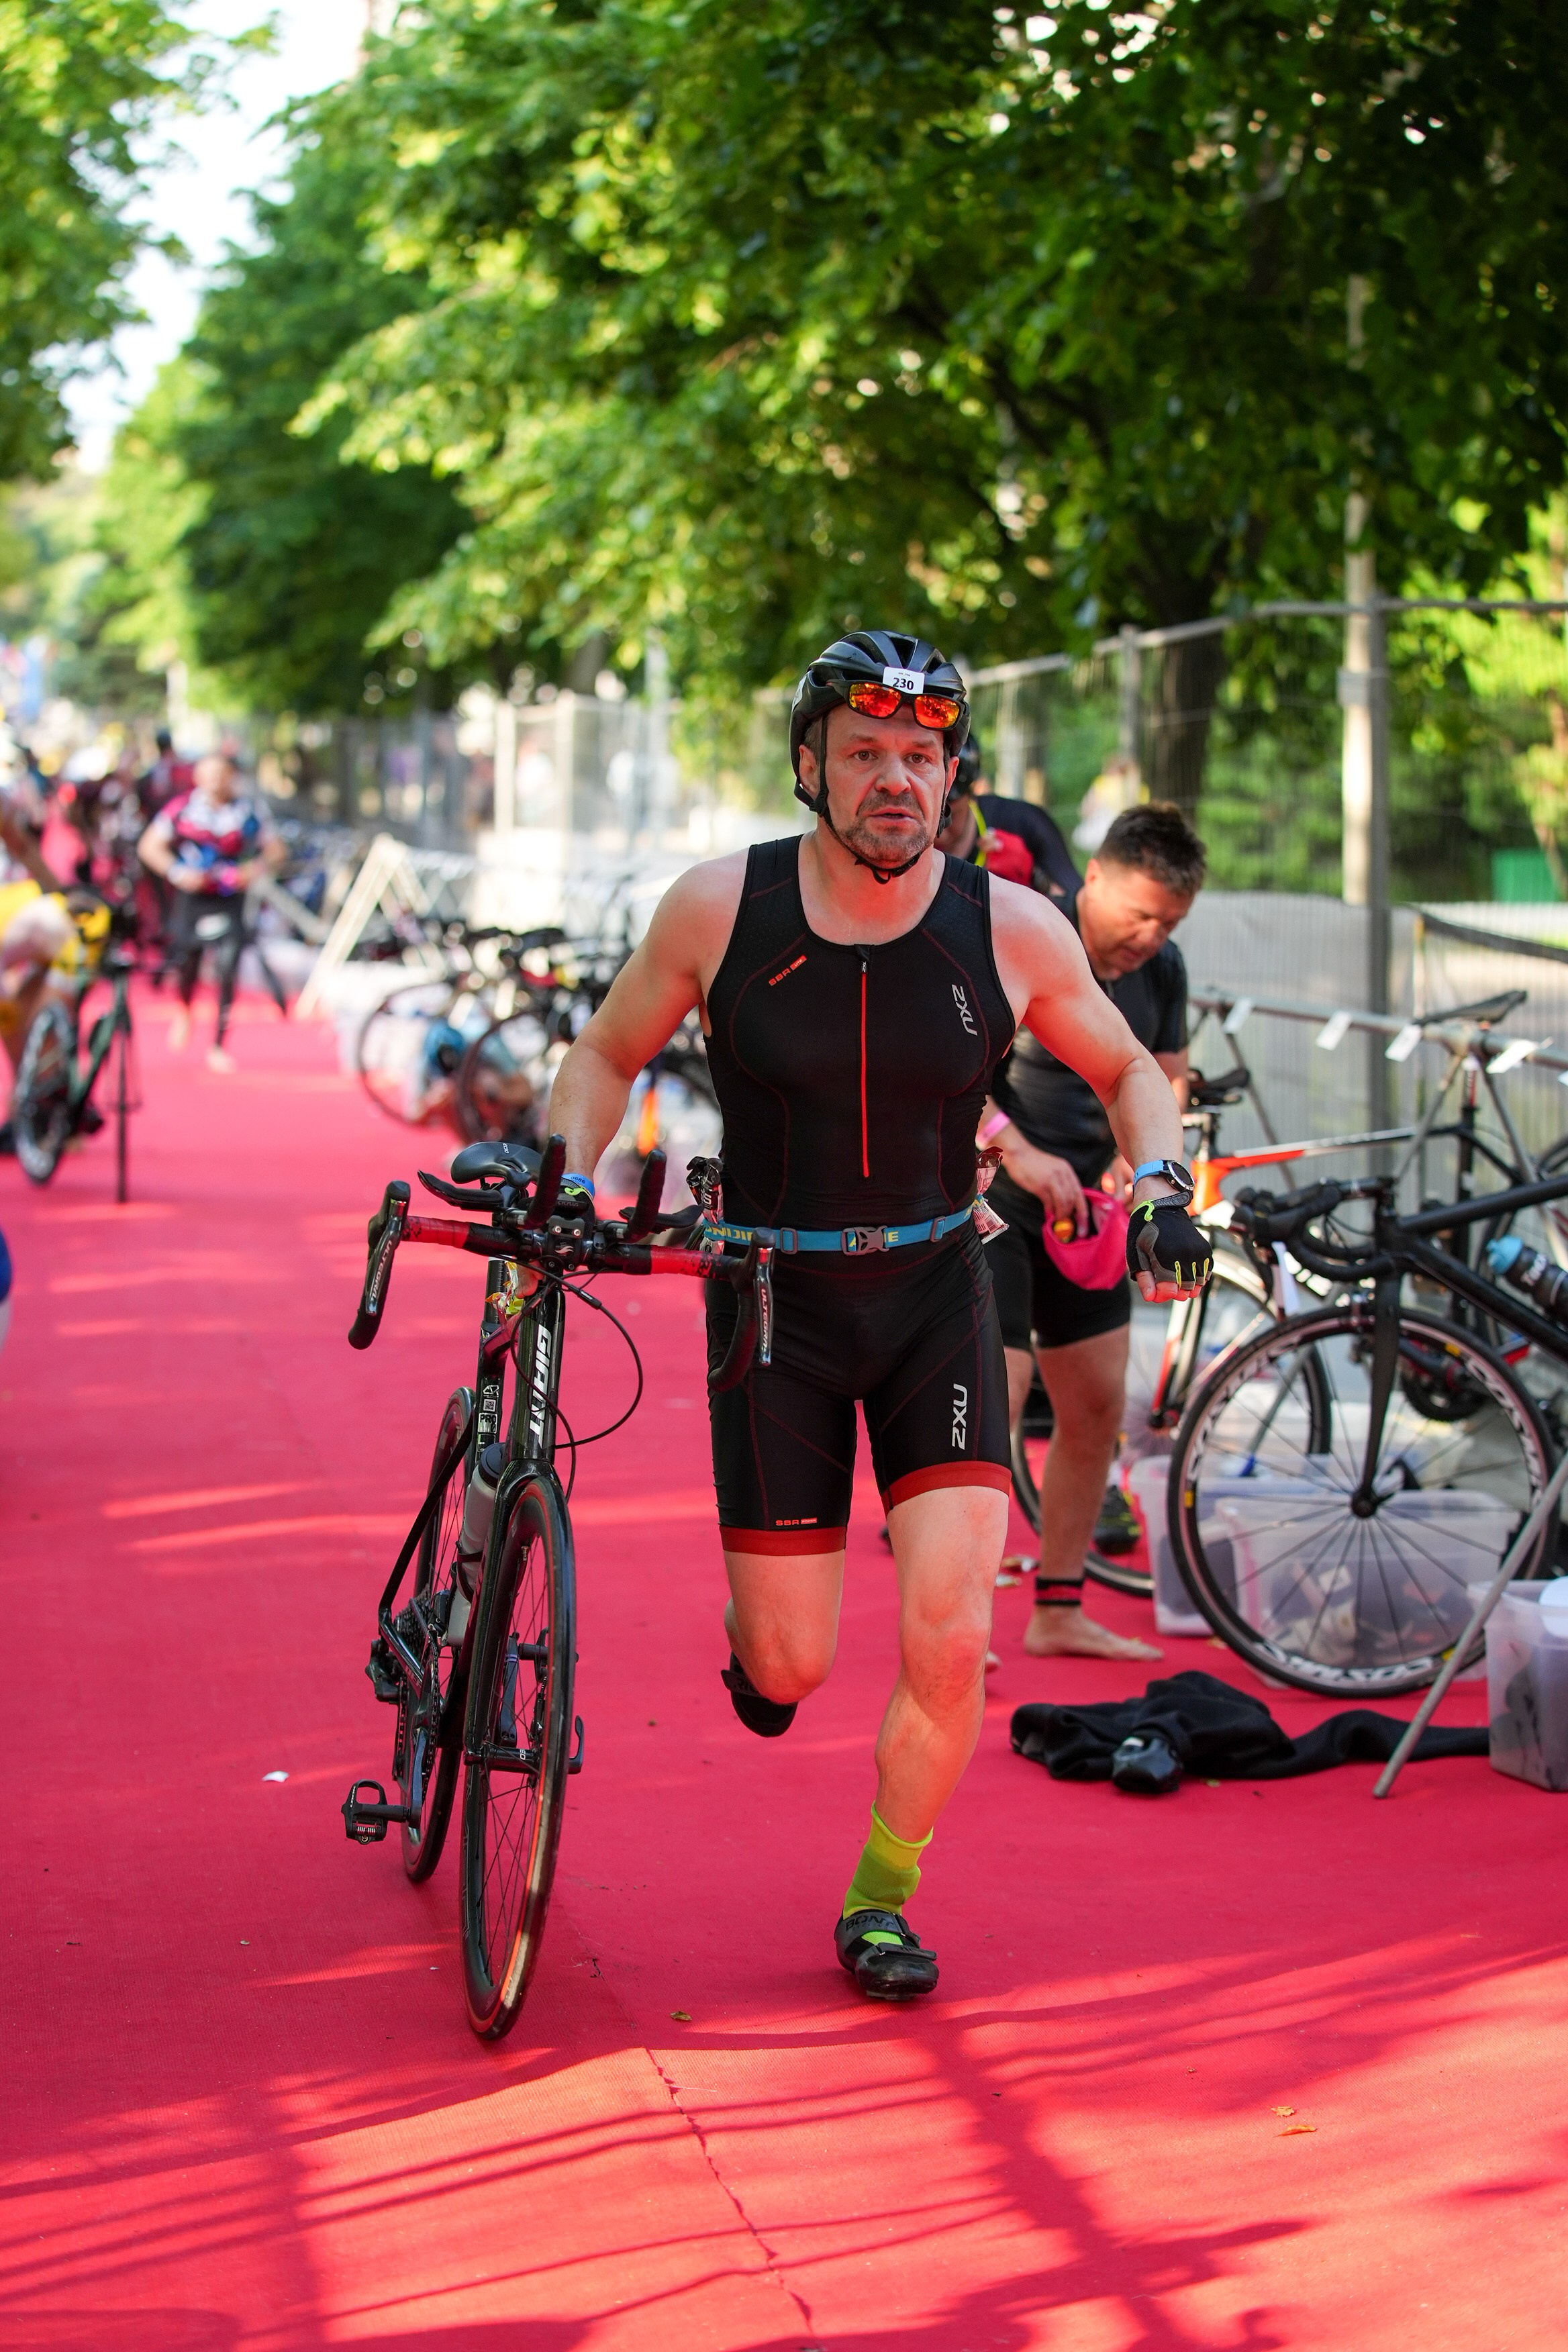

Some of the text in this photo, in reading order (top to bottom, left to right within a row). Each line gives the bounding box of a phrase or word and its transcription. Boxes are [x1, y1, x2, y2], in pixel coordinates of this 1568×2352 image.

[892, 677, 914, 691] 230
[768, 967, 791, 987] SBR
[951, 984, 978, 1036] 2XU
[371, 1240, 393, 1299] ULTEGRA
[761, 1288, 769, 1349] ULTEGRA
[529, 1324, 552, 1449] GIANT
[951, 1383, 968, 1451] 2XU
[846, 1915, 894, 1932] BONT
